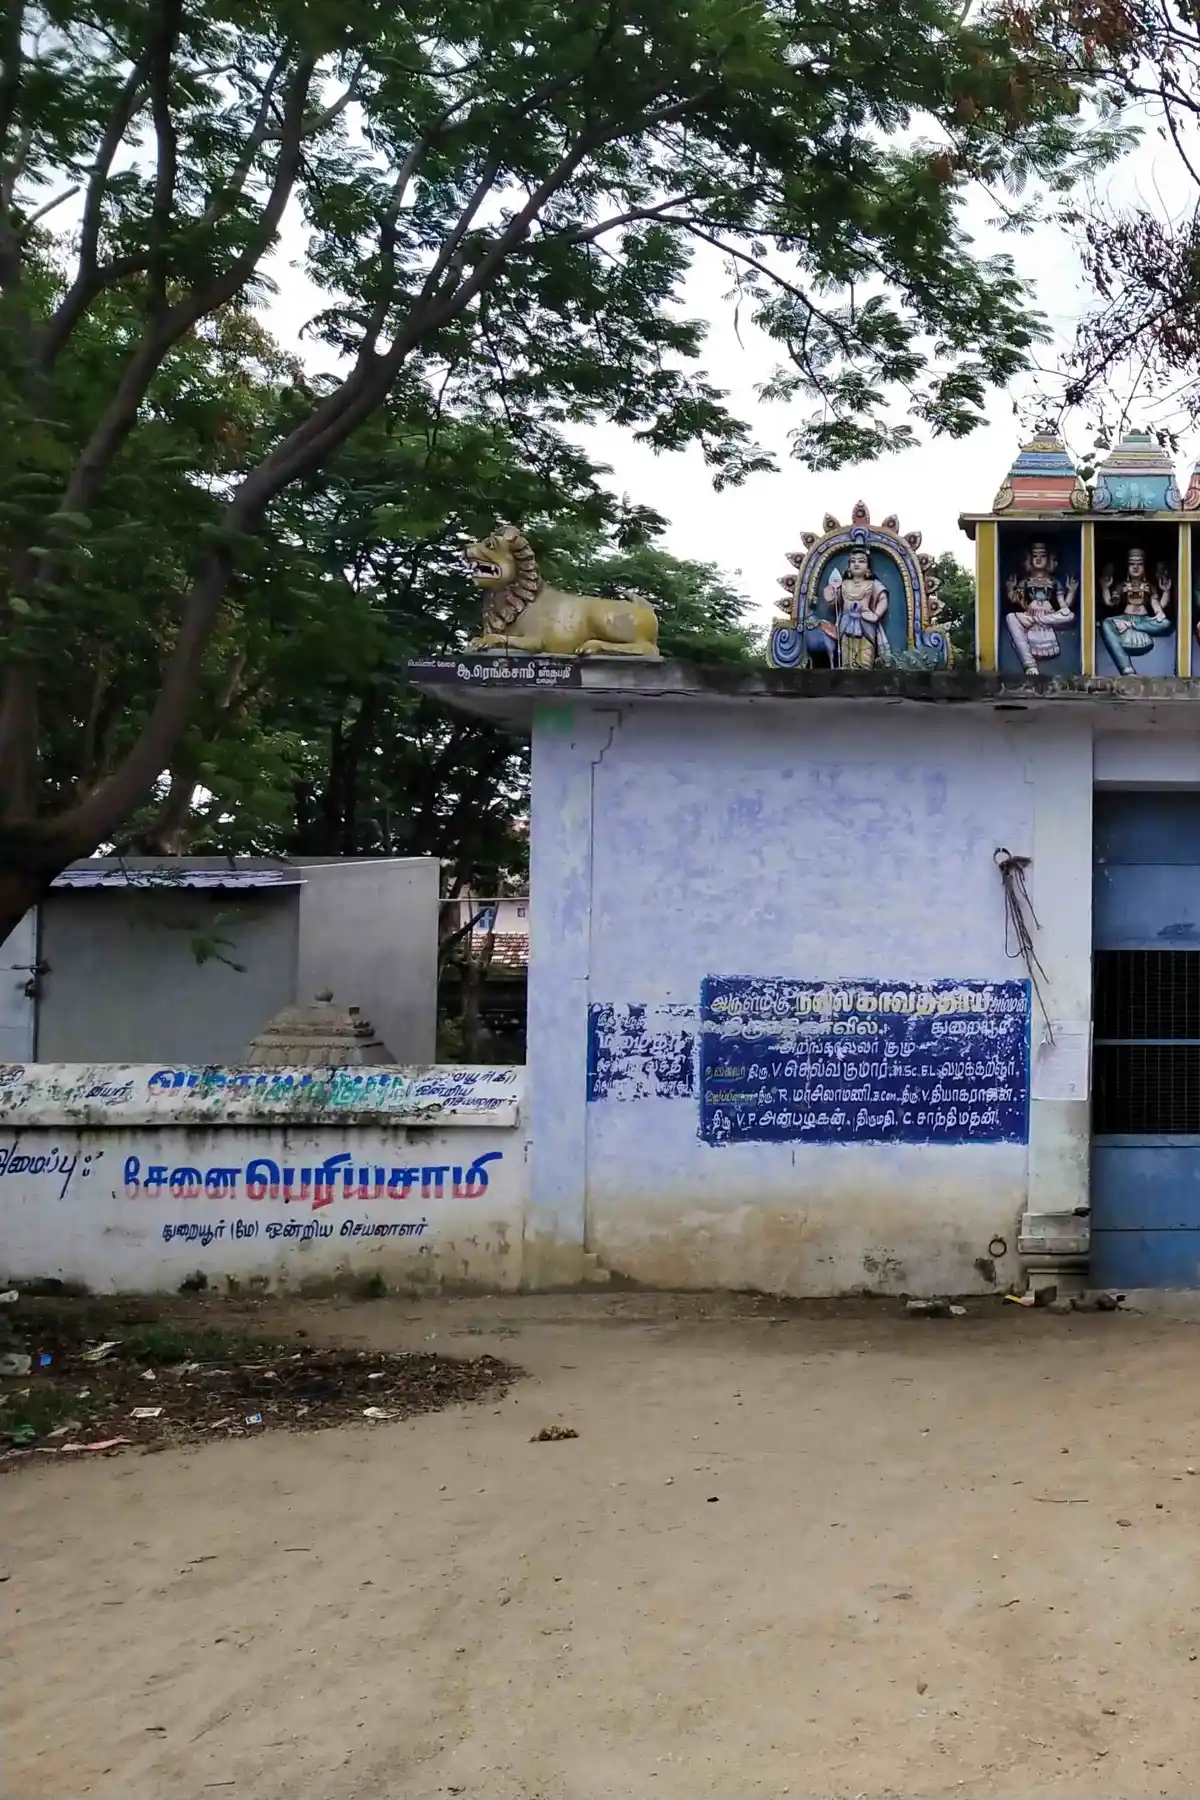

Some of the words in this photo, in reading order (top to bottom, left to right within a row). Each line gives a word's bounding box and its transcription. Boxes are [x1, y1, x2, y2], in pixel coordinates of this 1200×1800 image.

[162, 1219, 228, 1246] துறையூர்
[265, 1218, 334, 1242] ஒன்றிய
[340, 1217, 430, 1238] செயலாளர்
